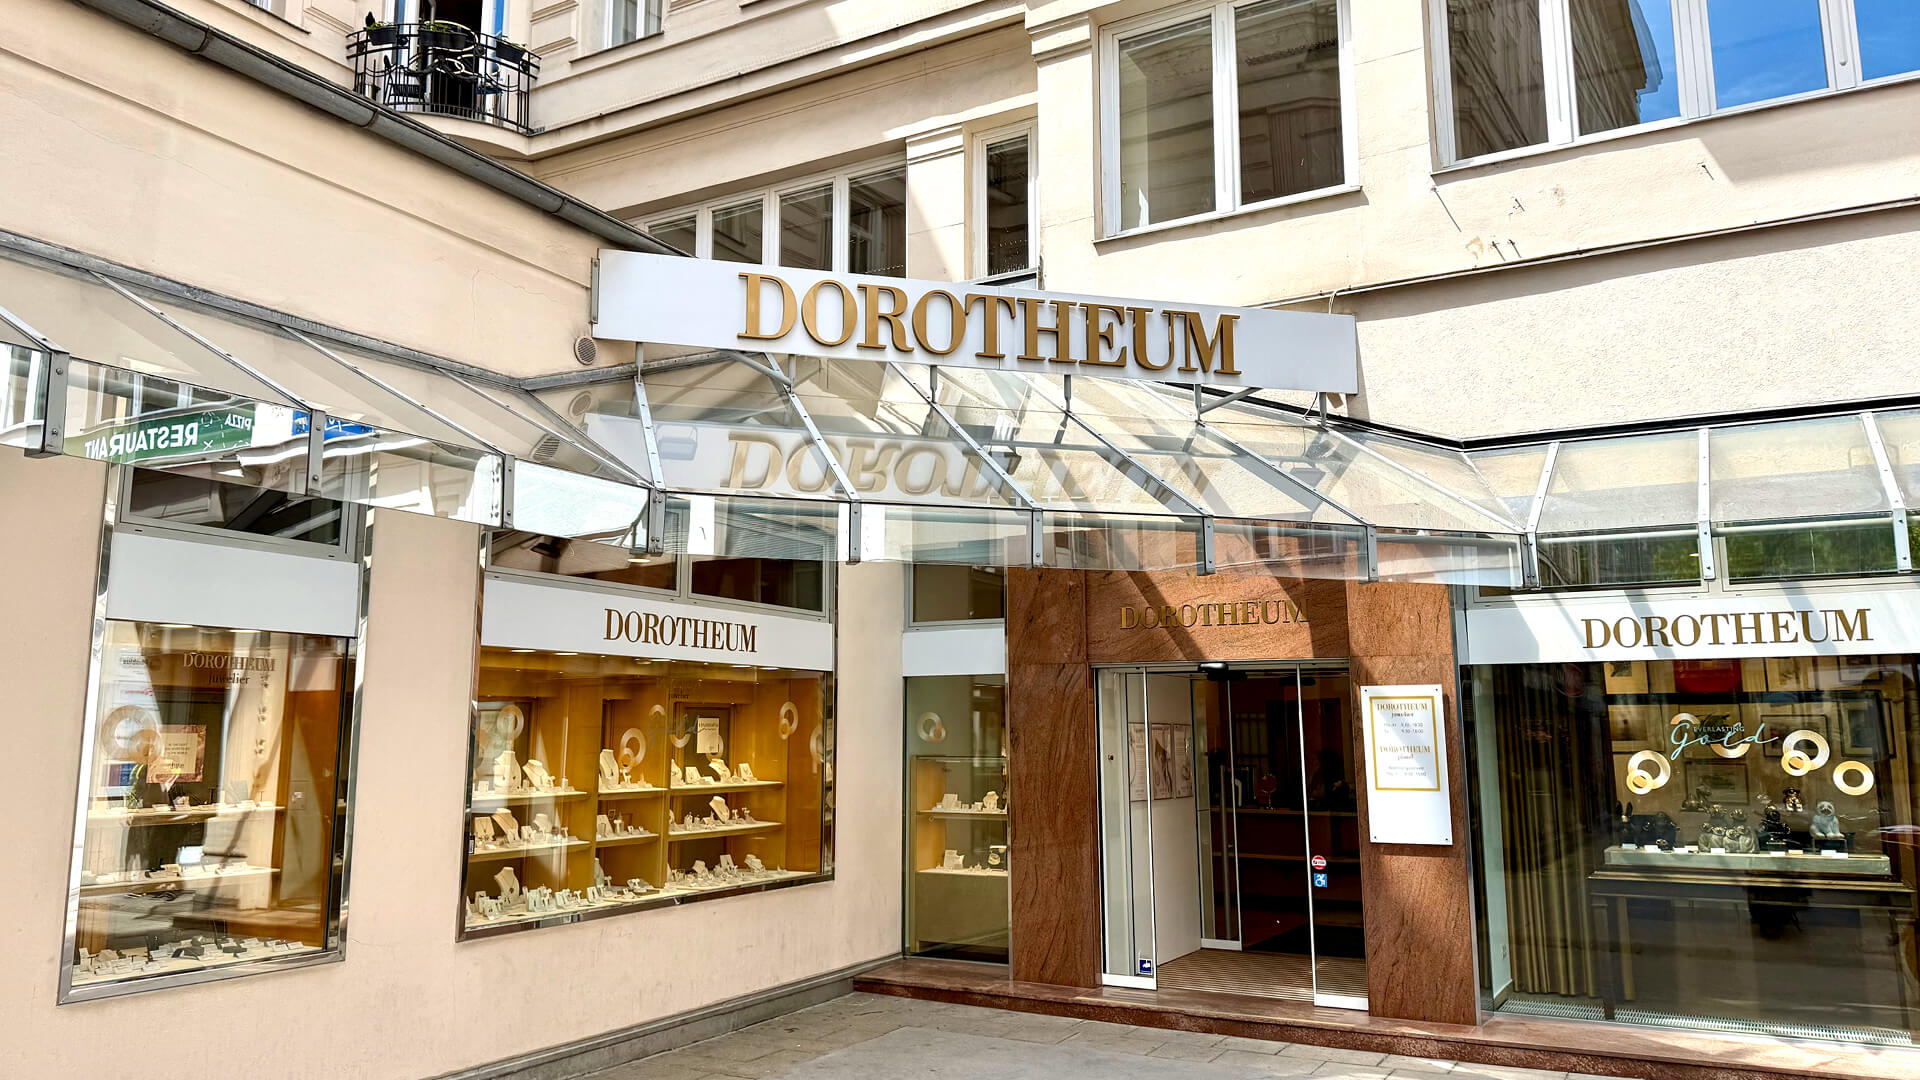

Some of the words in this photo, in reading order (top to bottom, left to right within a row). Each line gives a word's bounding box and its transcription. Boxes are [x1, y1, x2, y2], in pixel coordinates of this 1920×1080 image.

[737, 271, 1243, 376] DOROTHEUM
[603, 608, 758, 653] DOROTHEUM
[1119, 599, 1311, 630] DOROTHEUM
[1581, 608, 1874, 649] DOROTHEUM
[183, 652, 277, 672] DOROTHEUM
[208, 673, 250, 685] juwelier
[1671, 722, 1779, 760] Gold
[1693, 725, 1745, 733] EVERLASTING
